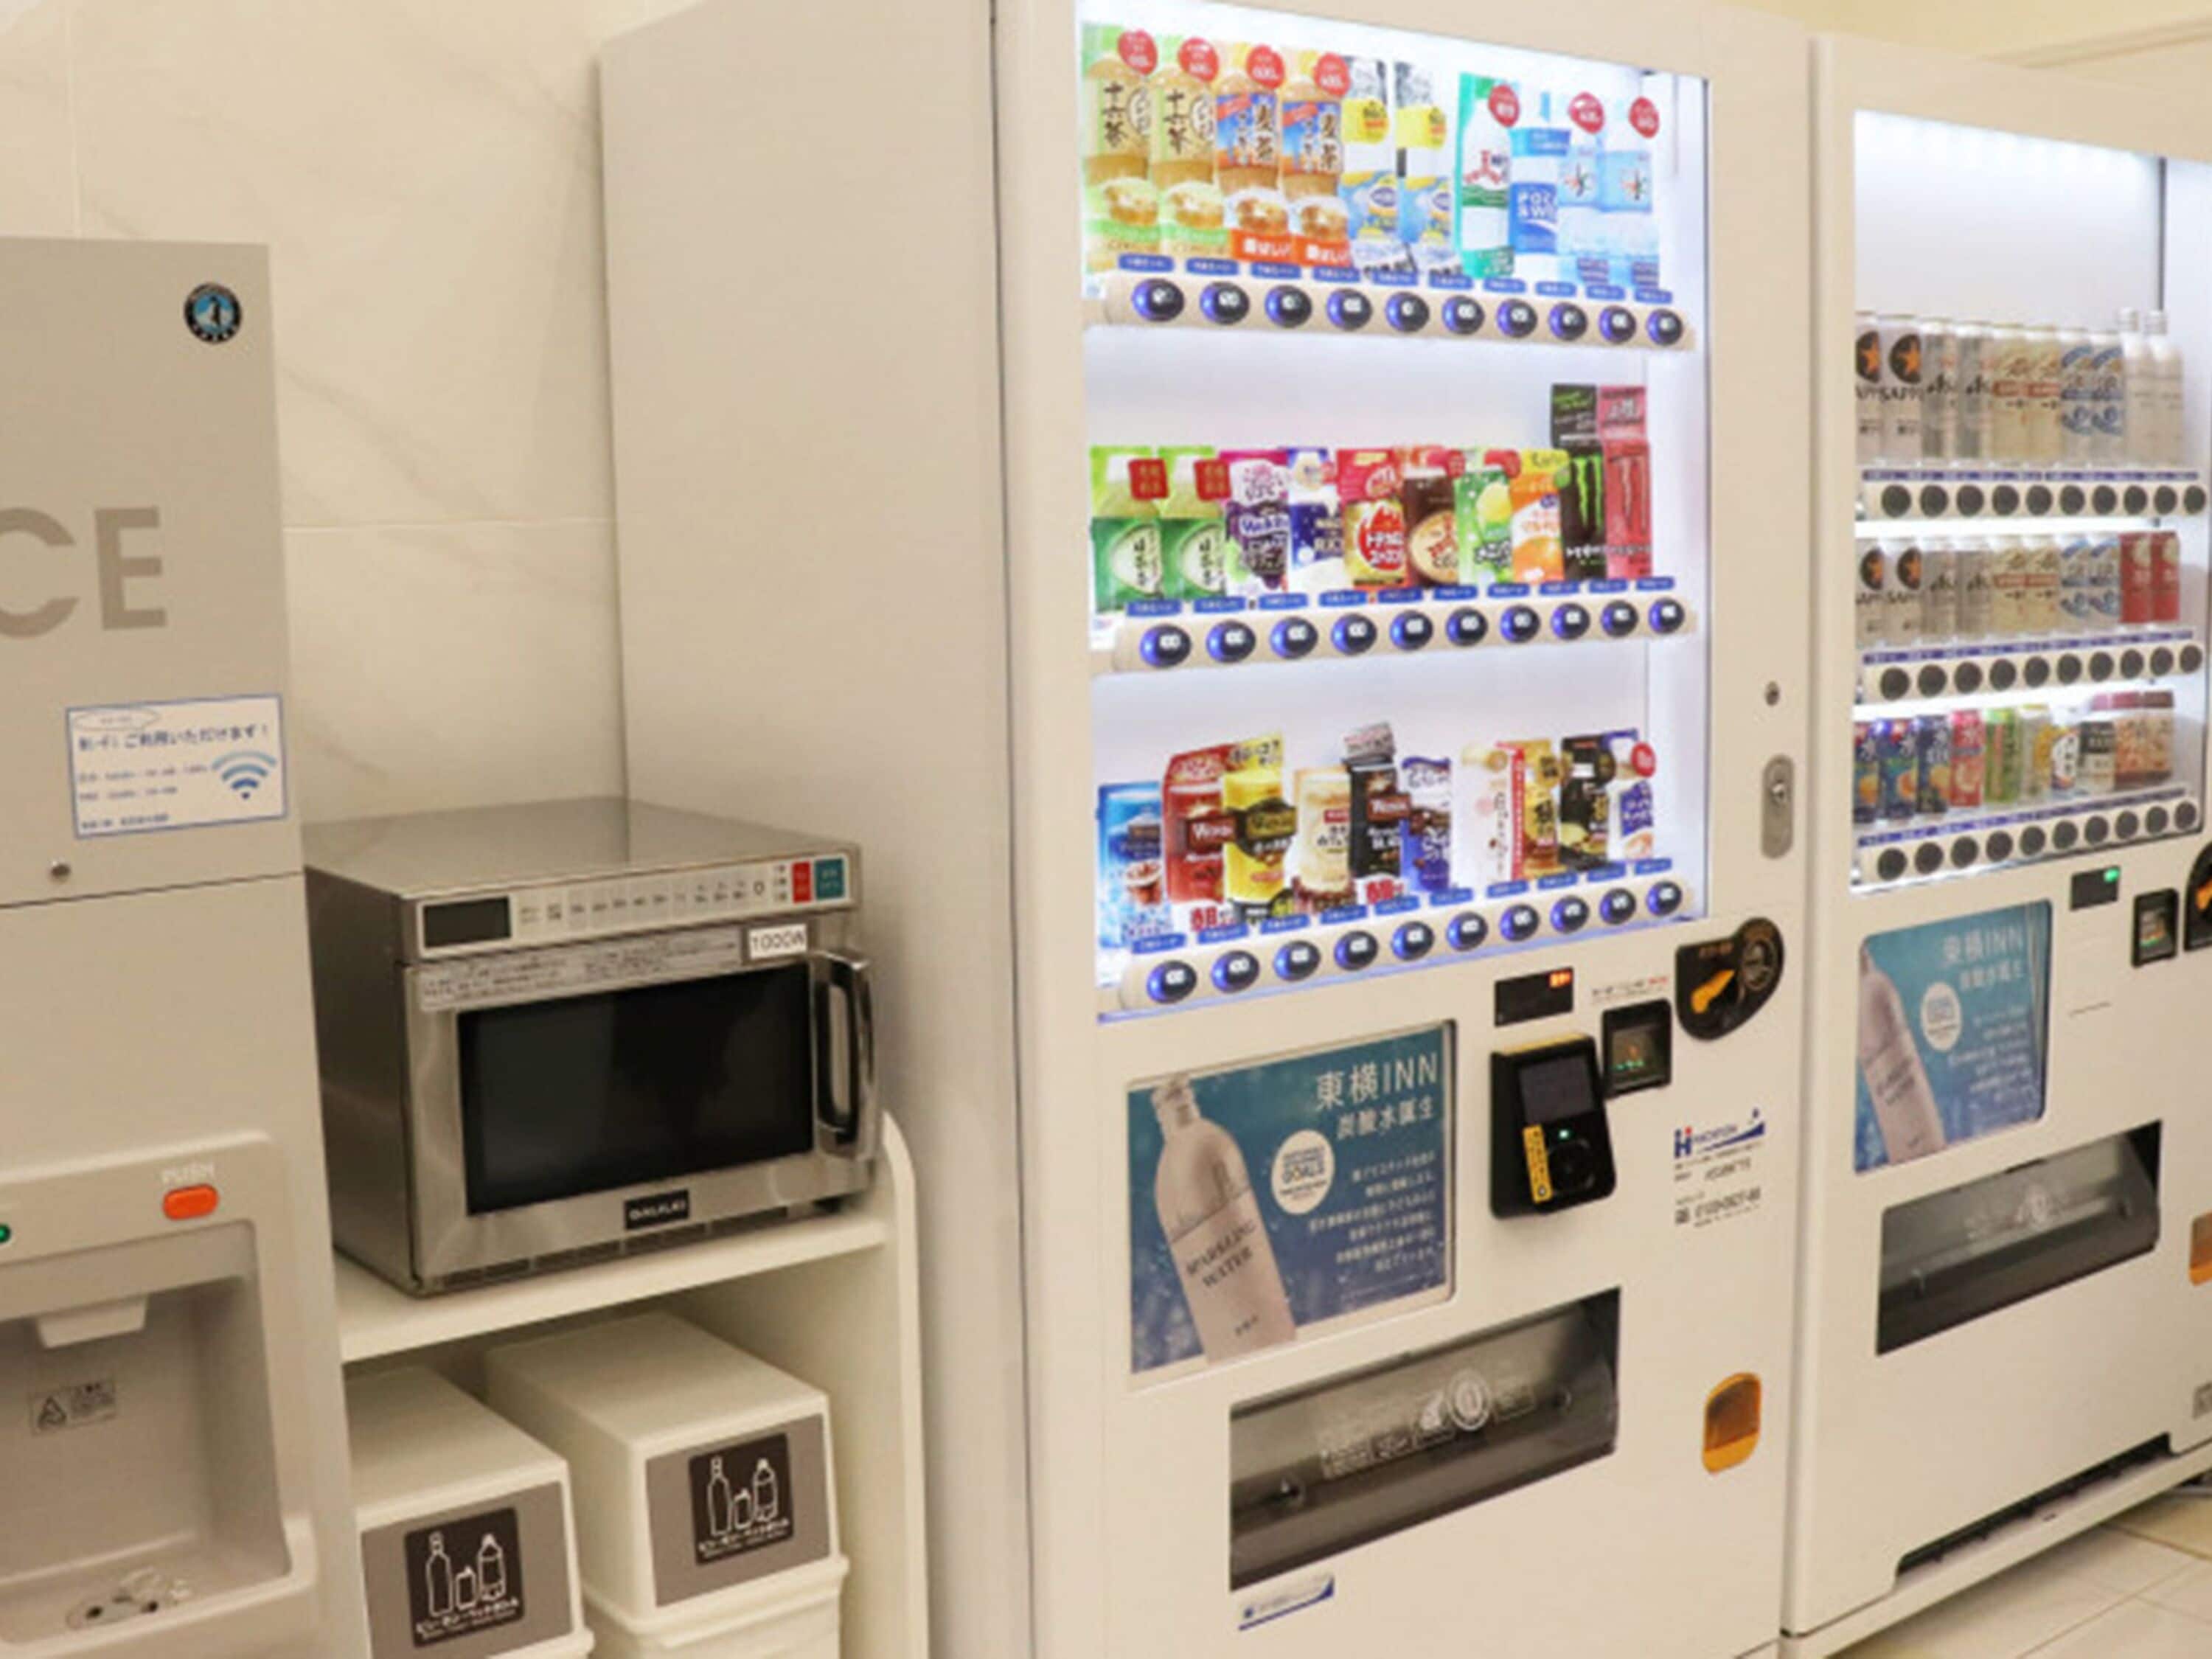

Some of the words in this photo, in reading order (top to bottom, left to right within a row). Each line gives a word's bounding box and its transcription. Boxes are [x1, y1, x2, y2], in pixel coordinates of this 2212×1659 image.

[752, 931, 805, 951] 1000W
[1315, 1052, 1437, 1111] 東横INN
[161, 1163, 215, 1184] PUSH
